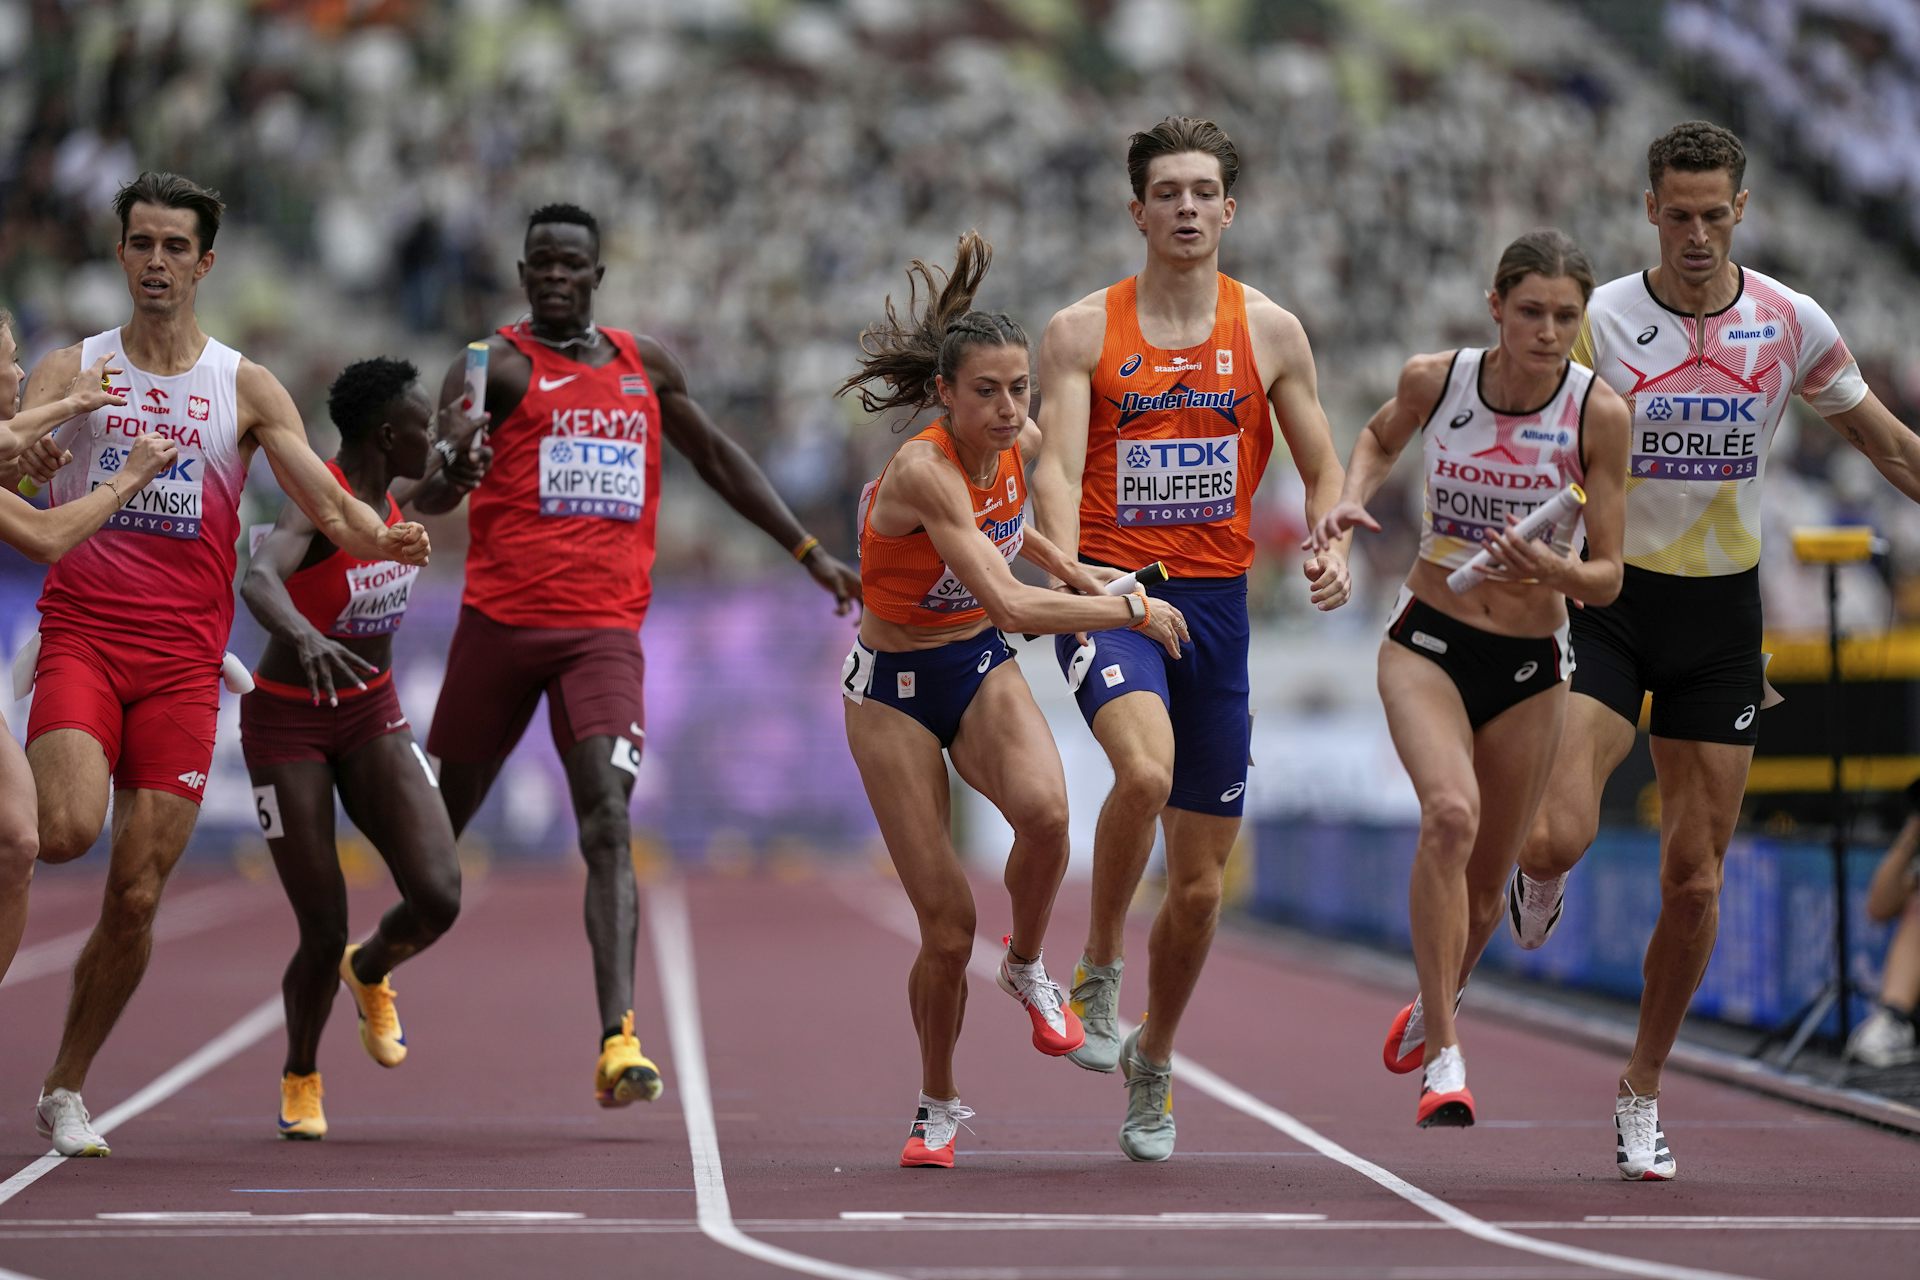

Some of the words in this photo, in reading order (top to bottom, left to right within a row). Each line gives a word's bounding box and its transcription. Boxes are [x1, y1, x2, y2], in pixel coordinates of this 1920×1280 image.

[1728, 329, 1761, 340] Allianz
[1154, 362, 1202, 373] Staatsloterij
[141, 404, 170, 414] ORLEN
[1120, 389, 1236, 412] Nederland
[1672, 397, 1757, 422] TDK
[552, 408, 648, 443] KENYA
[1520, 429, 1555, 442] Allianz
[574, 441, 637, 468] TDK
[1150, 440, 1230, 468] TDK
[1641, 428, 1756, 456] BORLÉE
[548, 470, 641, 497] KIPYEGO
[1124, 470, 1233, 501] PHIJFFERS
[1434, 459, 1557, 490] HONDA
[1436, 488, 1548, 522] PONETT
[257, 796, 272, 831] 6
